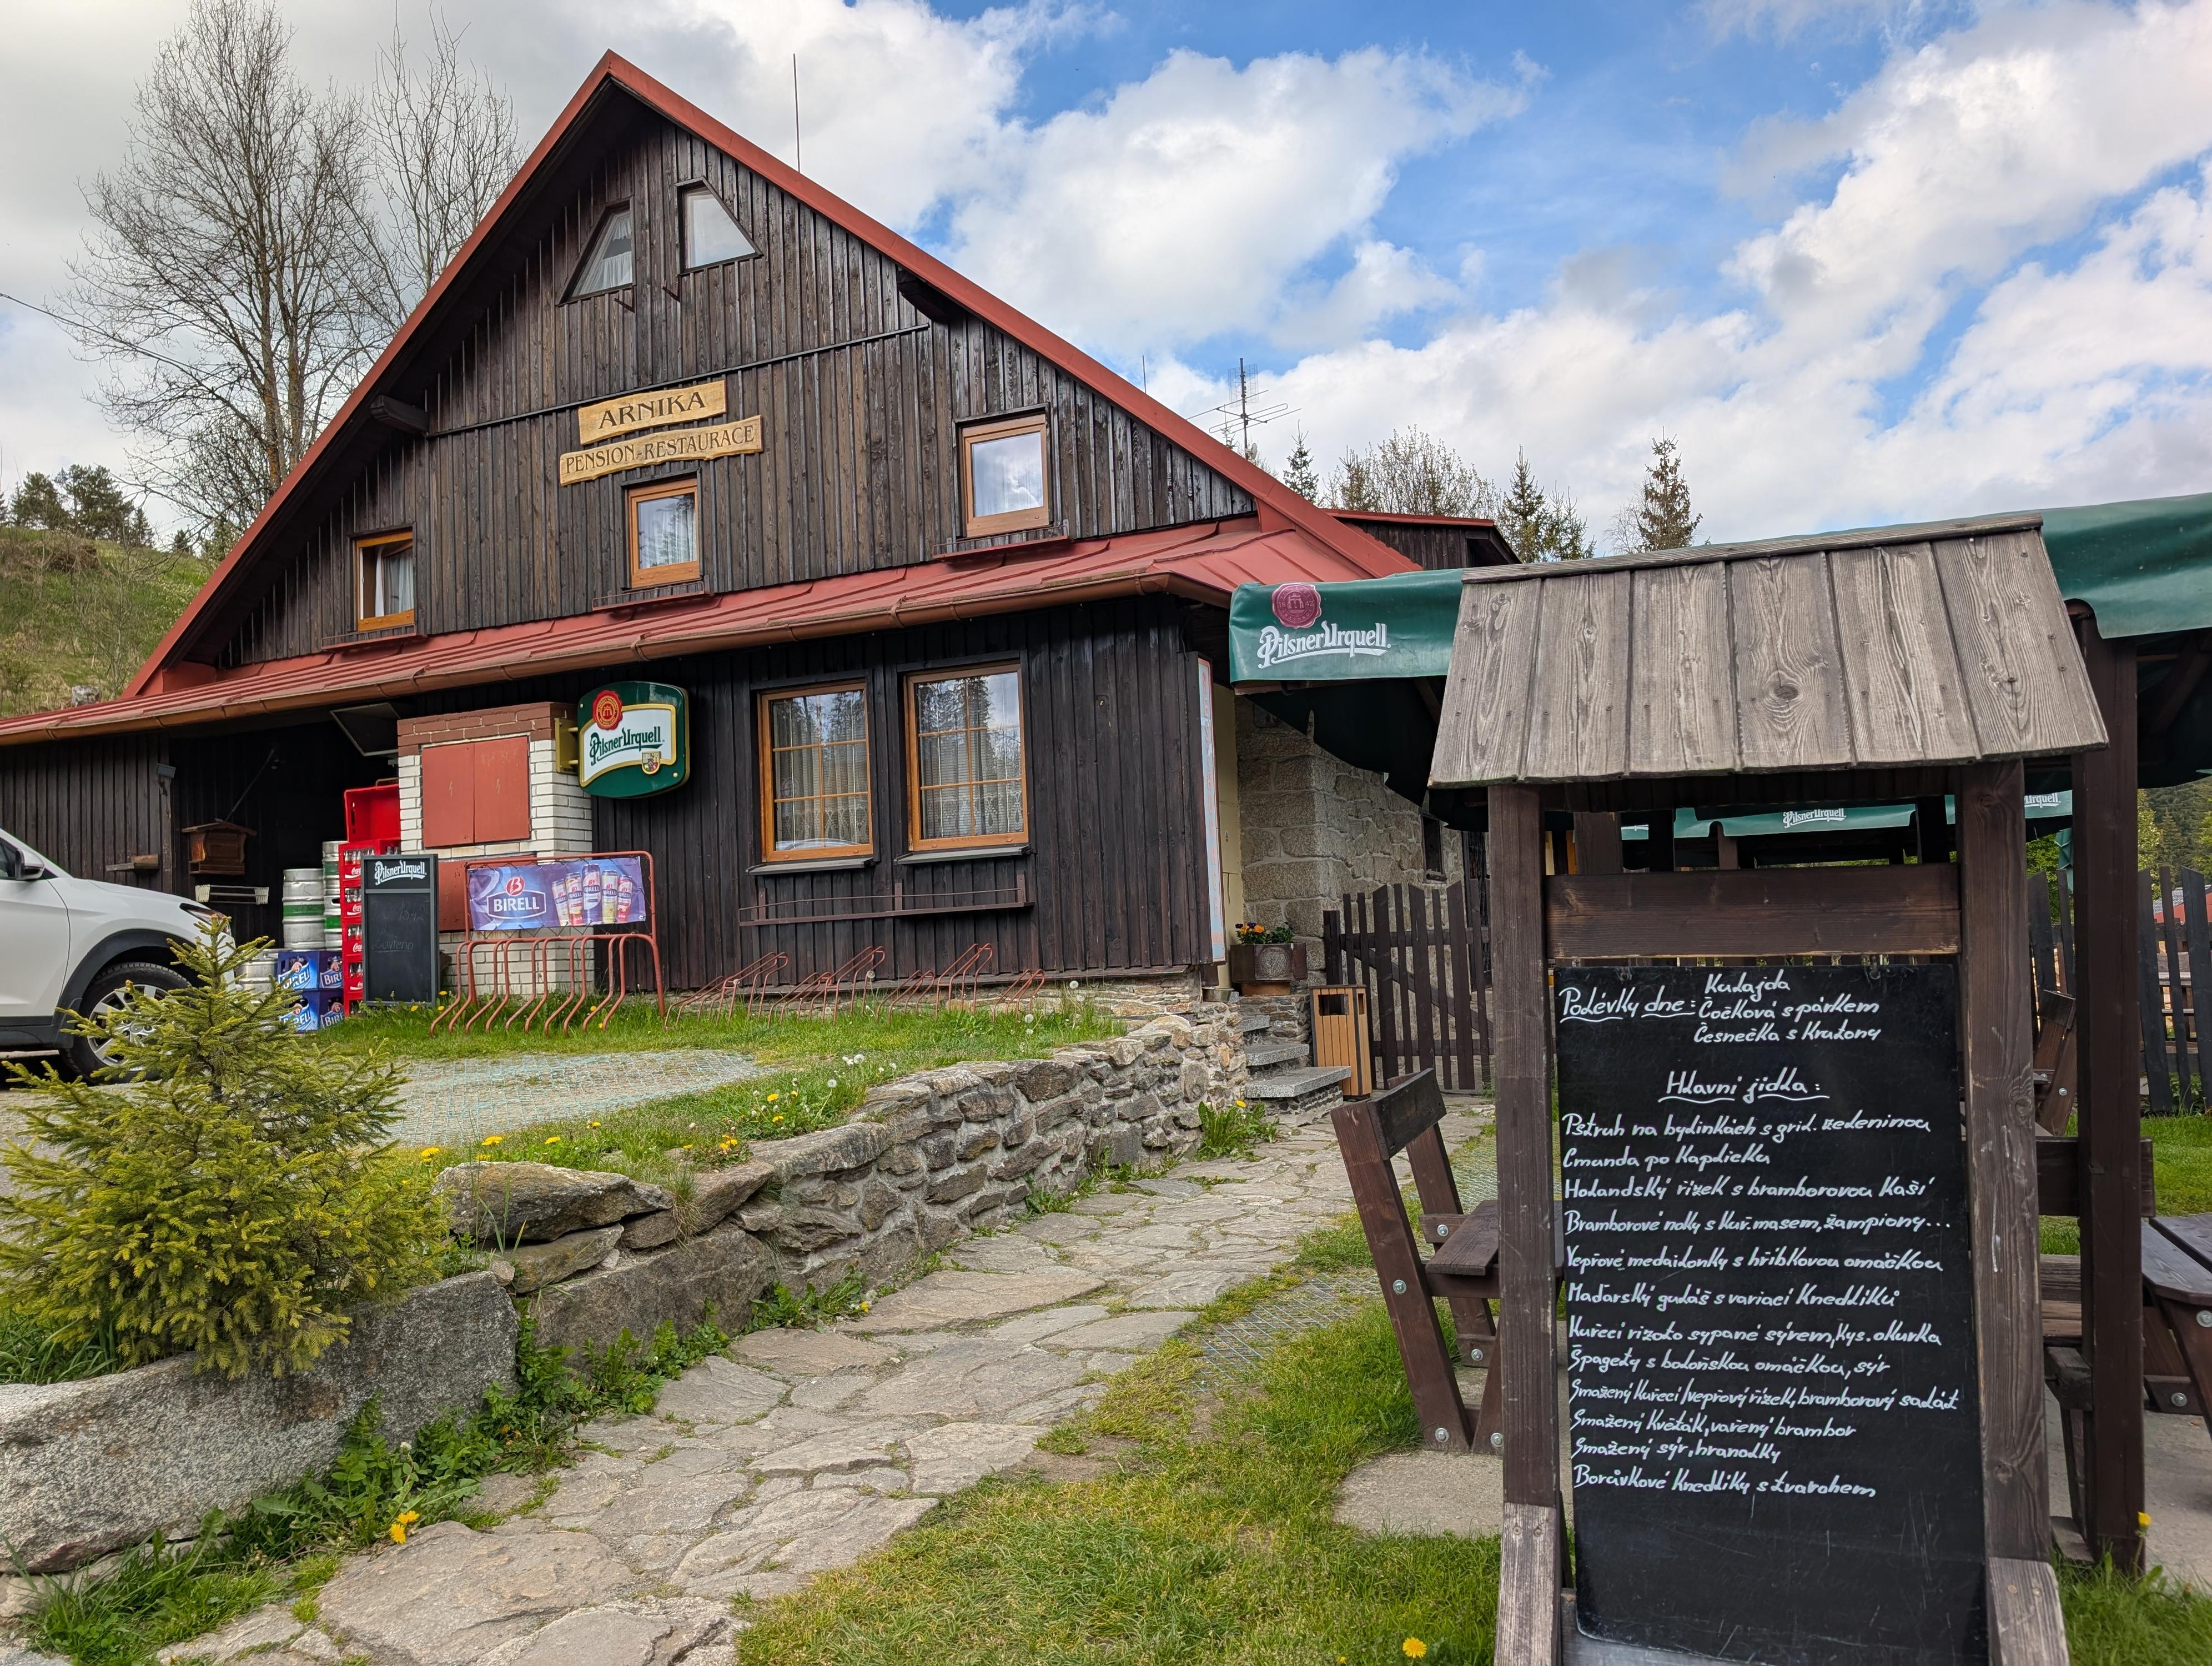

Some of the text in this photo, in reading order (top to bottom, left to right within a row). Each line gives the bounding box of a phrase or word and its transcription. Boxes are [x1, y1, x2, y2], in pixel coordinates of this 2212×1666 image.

[599, 392, 706, 429] ARNIKA
[566, 424, 755, 474] PENSION-RESTAURACE
[1257, 625, 1324, 669] Pilsner
[589, 726, 661, 766] Pilsner Urquell
[1783, 811, 1814, 828] Pilsner
[374, 861, 400, 886] Pilsner
[494, 896, 540, 912] BIRELL
[1559, 987, 1639, 1017] Polévky
[1786, 1030, 1797, 1039] s
[1667, 1071, 1742, 1094] Hlavní
[1562, 1113, 1625, 1137] Pstruh
[1632, 1125, 1657, 1136] na
[1759, 1125, 1772, 1135] s
[1645, 1156, 1670, 1172] po
[1731, 1186, 1743, 1196] s
[1705, 1221, 1716, 1230] s
[1732, 1257, 1743, 1267] s
[1714, 1294, 1725, 1304] s
[1646, 1358, 1656, 1368] s
